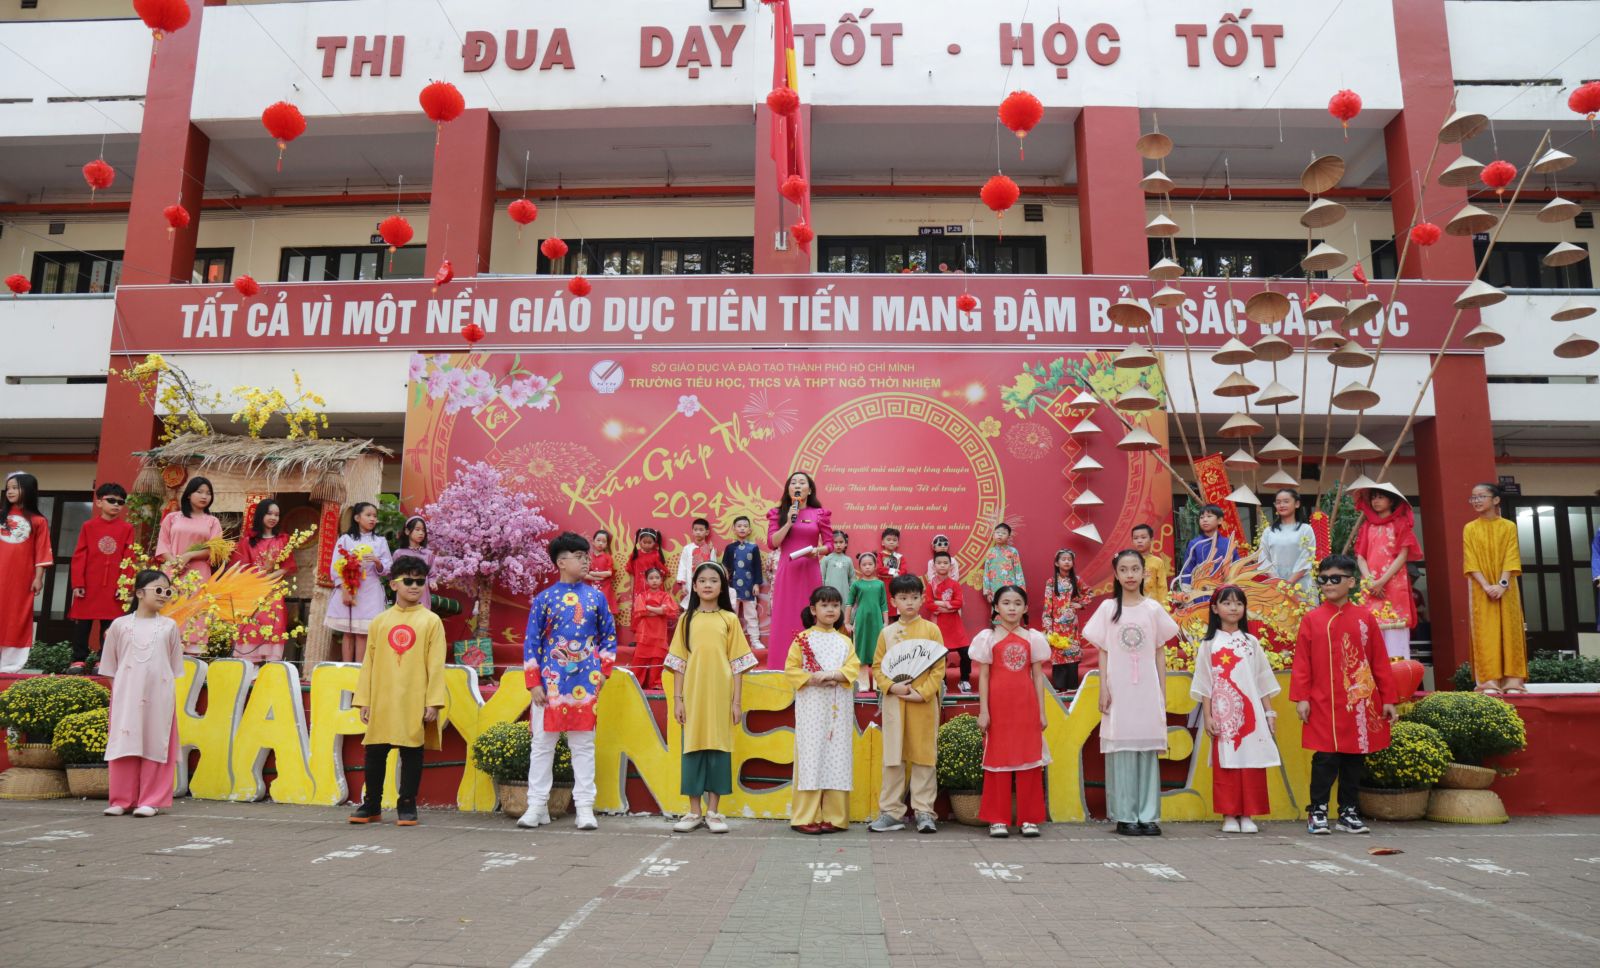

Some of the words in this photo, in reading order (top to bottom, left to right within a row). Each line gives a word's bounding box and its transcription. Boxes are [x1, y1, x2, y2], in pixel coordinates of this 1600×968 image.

[316, 35, 405, 77] THI
[461, 27, 575, 73] ĐUA
[639, 25, 746, 79] DẠY
[793, 7, 903, 66] TỐT
[999, 22, 1120, 79] HỌC
[1175, 8, 1283, 68] TỐT
[181, 291, 238, 338] TẤT
[246, 290, 290, 337] CẢ
[302, 295, 332, 336] VÌ
[342, 292, 416, 342] MỘT
[426, 288, 498, 334] NỀN
[508, 290, 592, 333] GIÁO
[602, 296, 675, 340] DỤC
[687, 288, 767, 332] TIÊN
[778, 284, 859, 332] TIẾN
[872, 296, 982, 332] MANG
[993, 288, 1077, 340] ĐẬM
[1176, 286, 1247, 335] SẮC
[628, 376, 682, 388] TRƯỜNG
[686, 376, 712, 388] TIỂU
[716, 378, 744, 390] HỌC,
[749, 378, 780, 388] THCS
[784, 376, 800, 388] VÀ
[804, 377, 836, 388] THPT
[839, 376, 866, 388] NGÔ
[870, 376, 898, 388] THỜI
[902, 376, 941, 390] NHIỆM
[651, 362, 666, 372] SỞ
[669, 362, 694, 372] GIÁO
[698, 363, 720, 373] DỤC
[722, 362, 736, 372] VÀ
[738, 362, 760, 372] ĐÀO
[764, 363, 784, 373] TẠO
[788, 362, 822, 372] THÀNH
[824, 362, 847, 372] PHỐ
[868, 362, 886, 372] CHÍ
[560, 470, 643, 515] Xuân
[642, 444, 714, 482] Giáp
[652, 490, 726, 518] 2024
